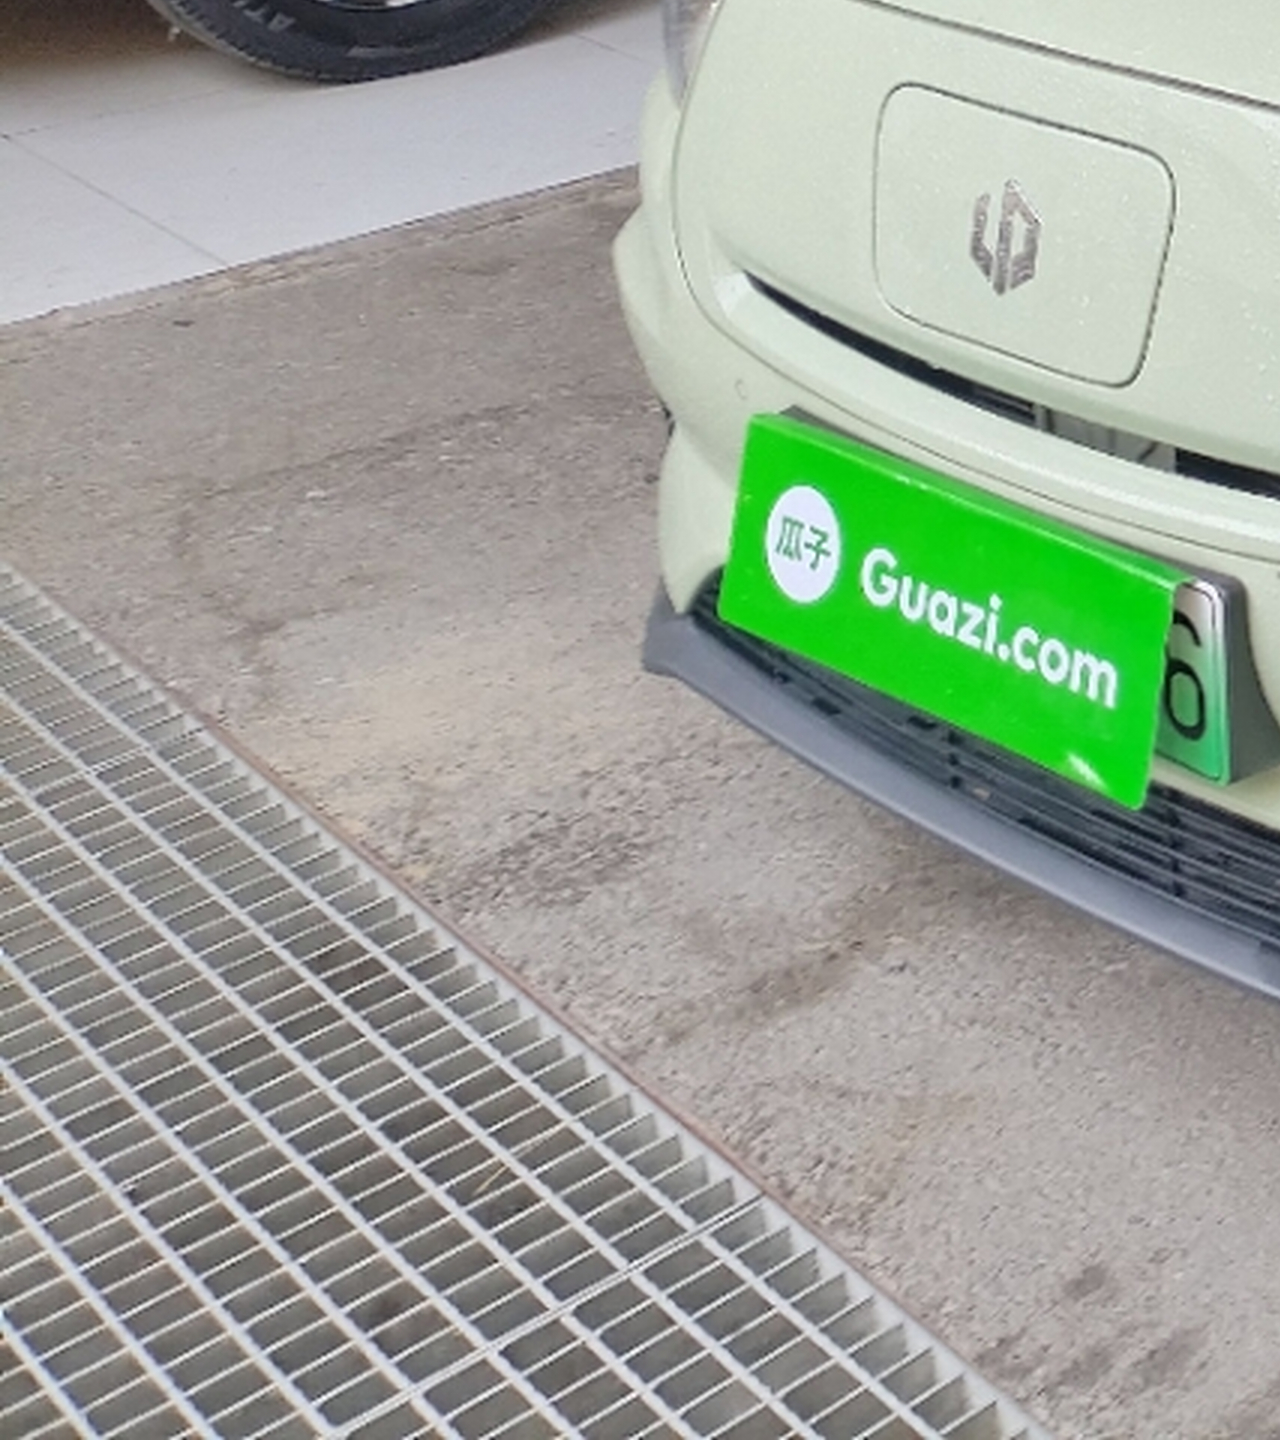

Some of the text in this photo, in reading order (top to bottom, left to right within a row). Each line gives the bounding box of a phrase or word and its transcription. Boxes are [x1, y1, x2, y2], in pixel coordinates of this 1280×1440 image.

[774, 515, 832, 572] 瓜子
[860, 547, 1119, 710] Guazi.com
[1163, 608, 1207, 741] 6
